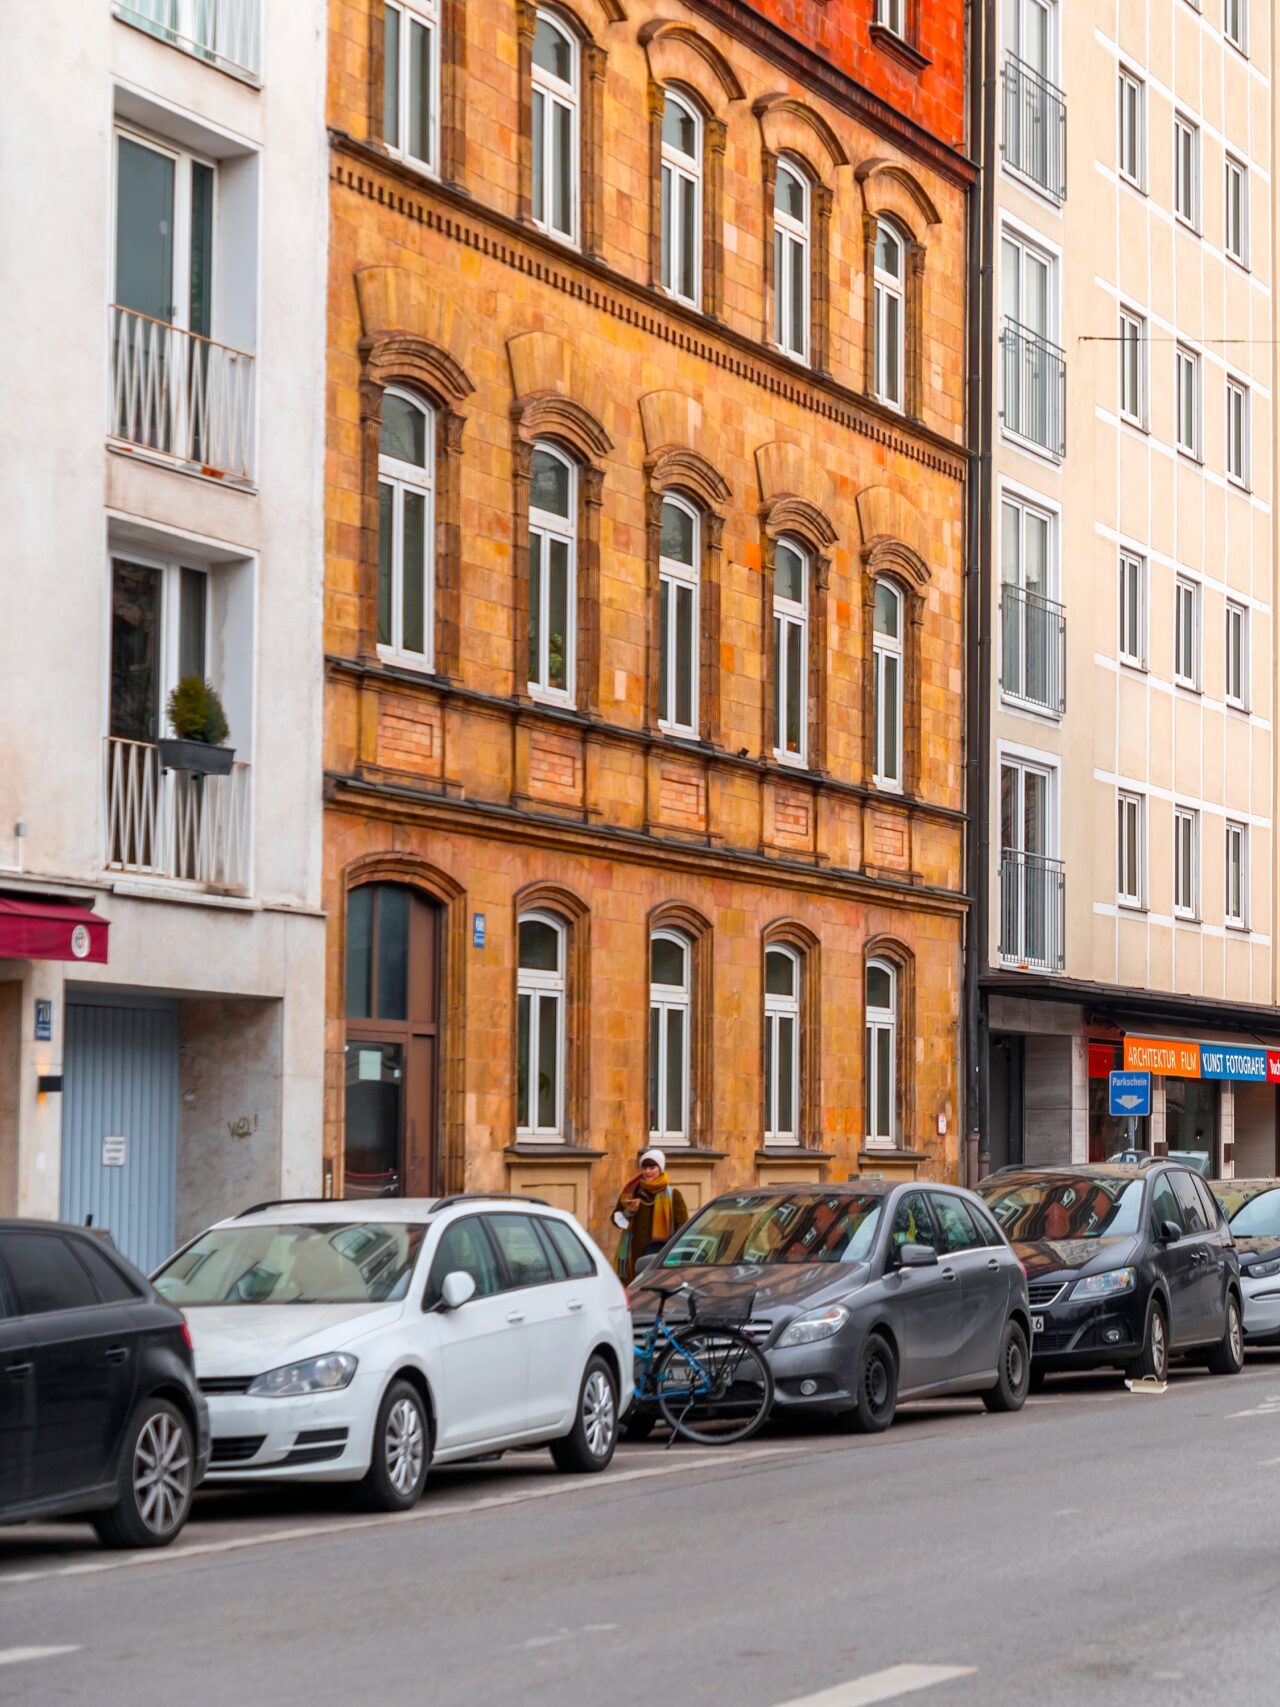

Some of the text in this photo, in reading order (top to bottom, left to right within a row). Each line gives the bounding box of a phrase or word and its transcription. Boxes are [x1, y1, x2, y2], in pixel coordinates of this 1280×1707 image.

[1127, 1046, 1197, 1071] ARCHITEKTUR FILM
[1202, 1052, 1266, 1076] KUNST FOTOGRAFIE
[1112, 1076, 1147, 1087] Parkschein
